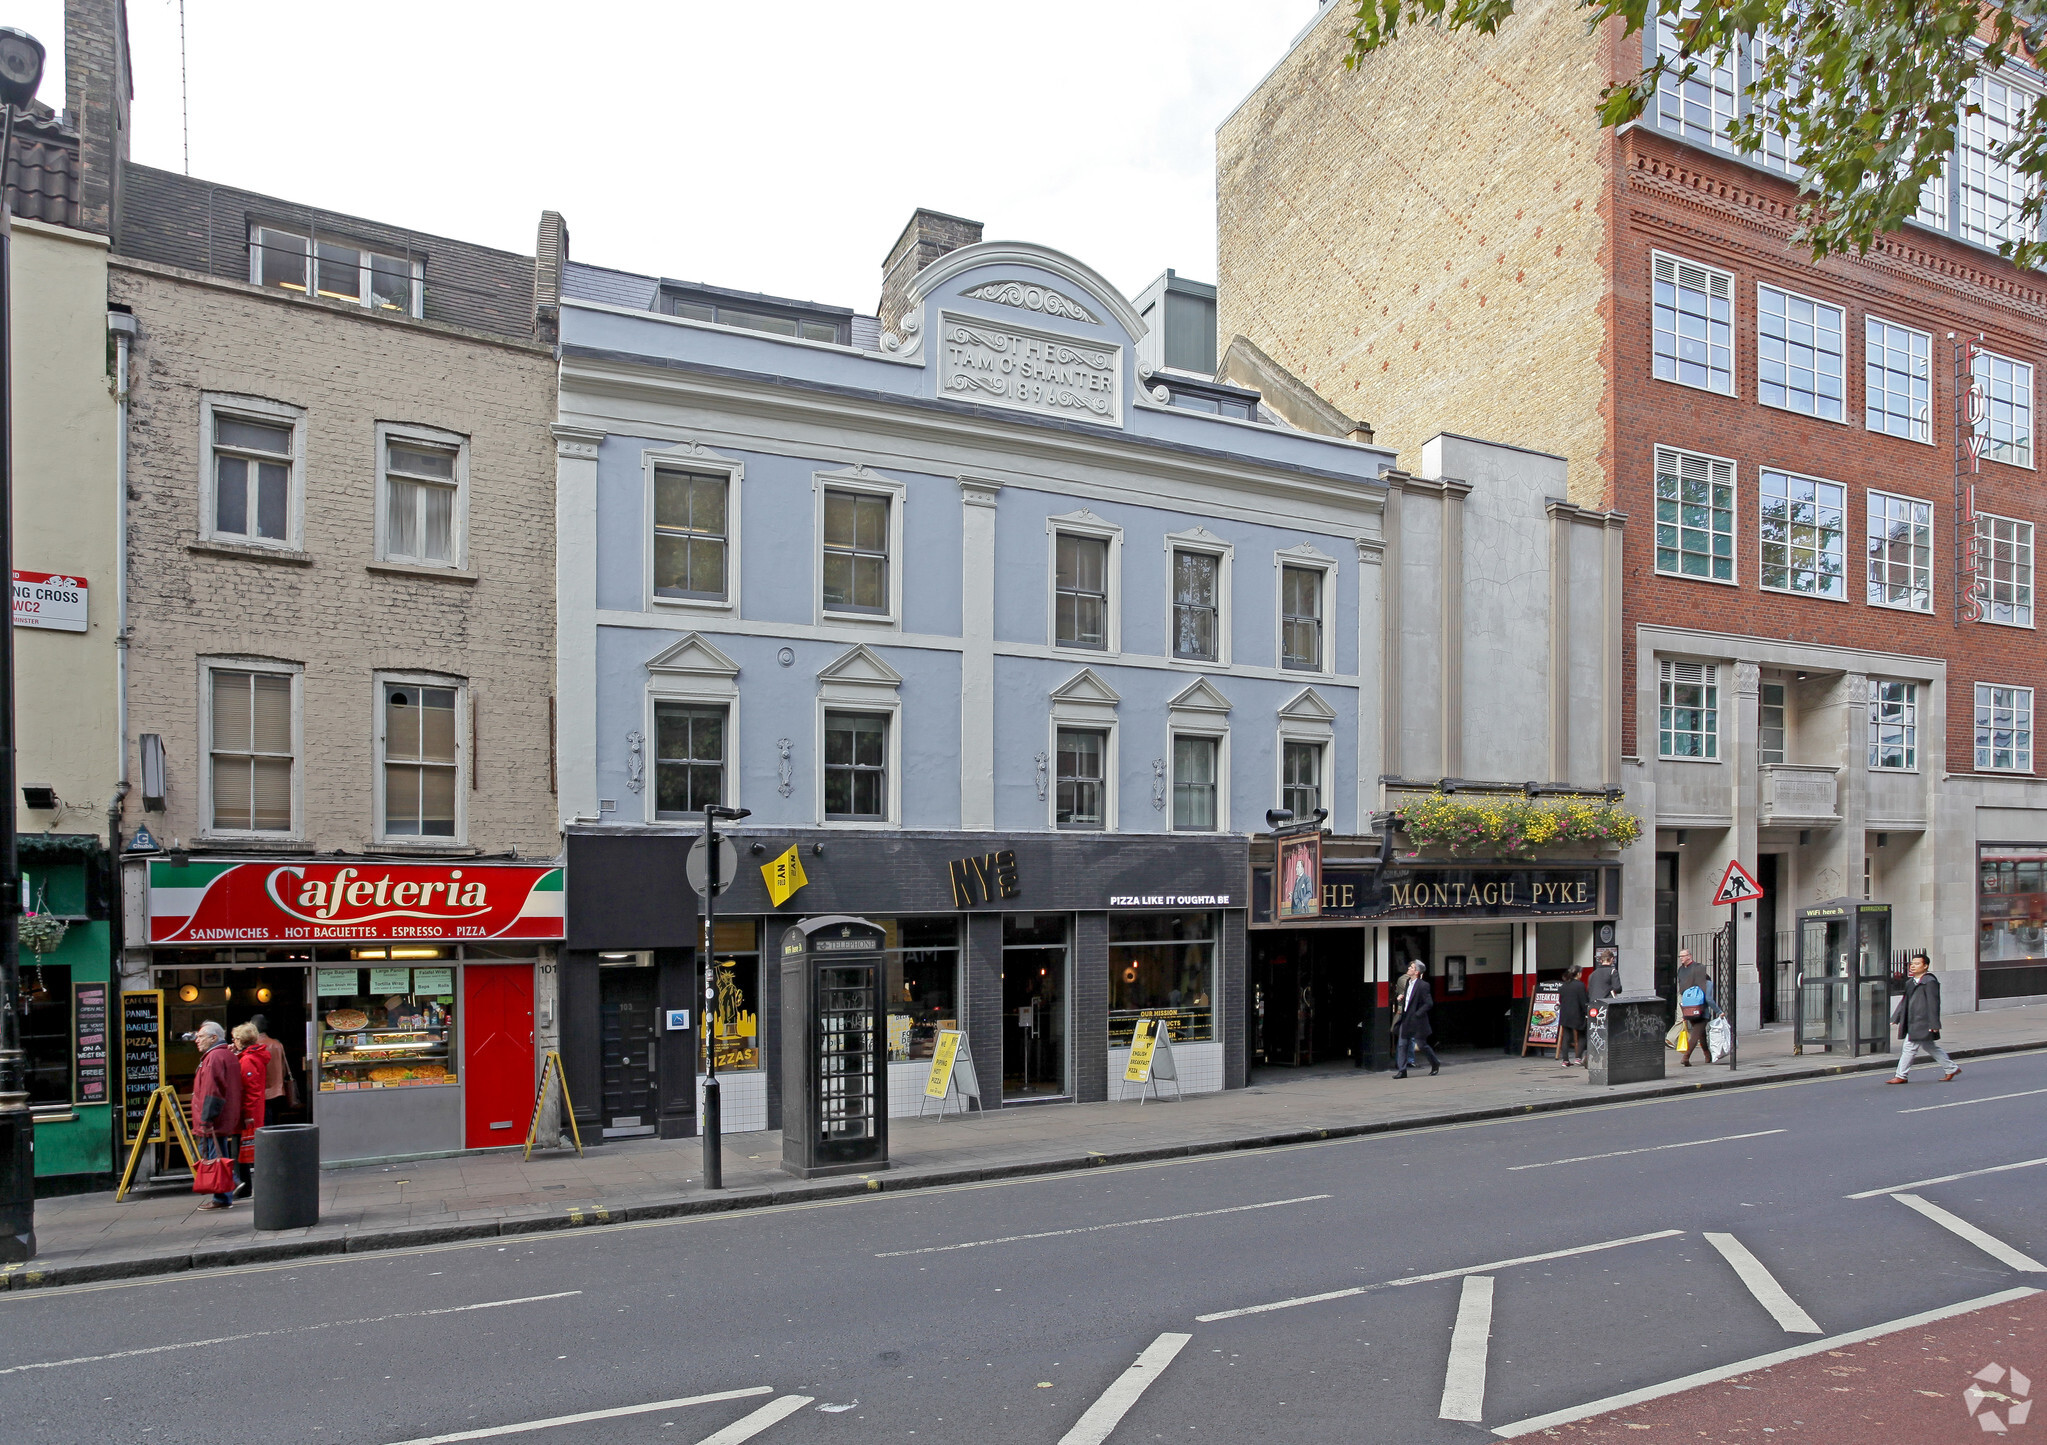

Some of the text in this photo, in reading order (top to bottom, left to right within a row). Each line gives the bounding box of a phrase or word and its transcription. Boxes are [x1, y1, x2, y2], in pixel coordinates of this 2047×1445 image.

[1007, 336, 1056, 363] THE
[950, 348, 994, 371] TAM
[1007, 378, 1057, 405] 1896
[1963, 332, 1986, 623] FOYLES
[36, 588, 79, 604] CROSS
[13, 600, 40, 613] WC2
[777, 864, 786, 879] NY
[948, 853, 995, 910] NY
[265, 865, 492, 925] Cafeteria
[1110, 895, 1230, 906] PIZZA LIKE IT OUGHTA BE
[1321, 881, 1588, 908] HE MONTAGU PYKE
[190, 926, 487, 940] SANDWICHES HOT BAGUETTES ESPRESSO PIZZA
[831, 940, 876, 950] TELEPHONE
[539, 965, 557, 975] 101
[1535, 993, 1551, 1001] STEAK
[126, 1009, 151, 1018] PANINI
[620, 1003, 633, 1011] 103
[1154, 1009, 1178, 1017] MISSION
[126, 1037, 154, 1047] PIZZA
[126, 1051, 158, 1060] FALAFEL
[714, 1049, 752, 1068] IZZAS
[81, 1069, 105, 1077] FREE
[931, 1076, 942, 1085] PIZZA
